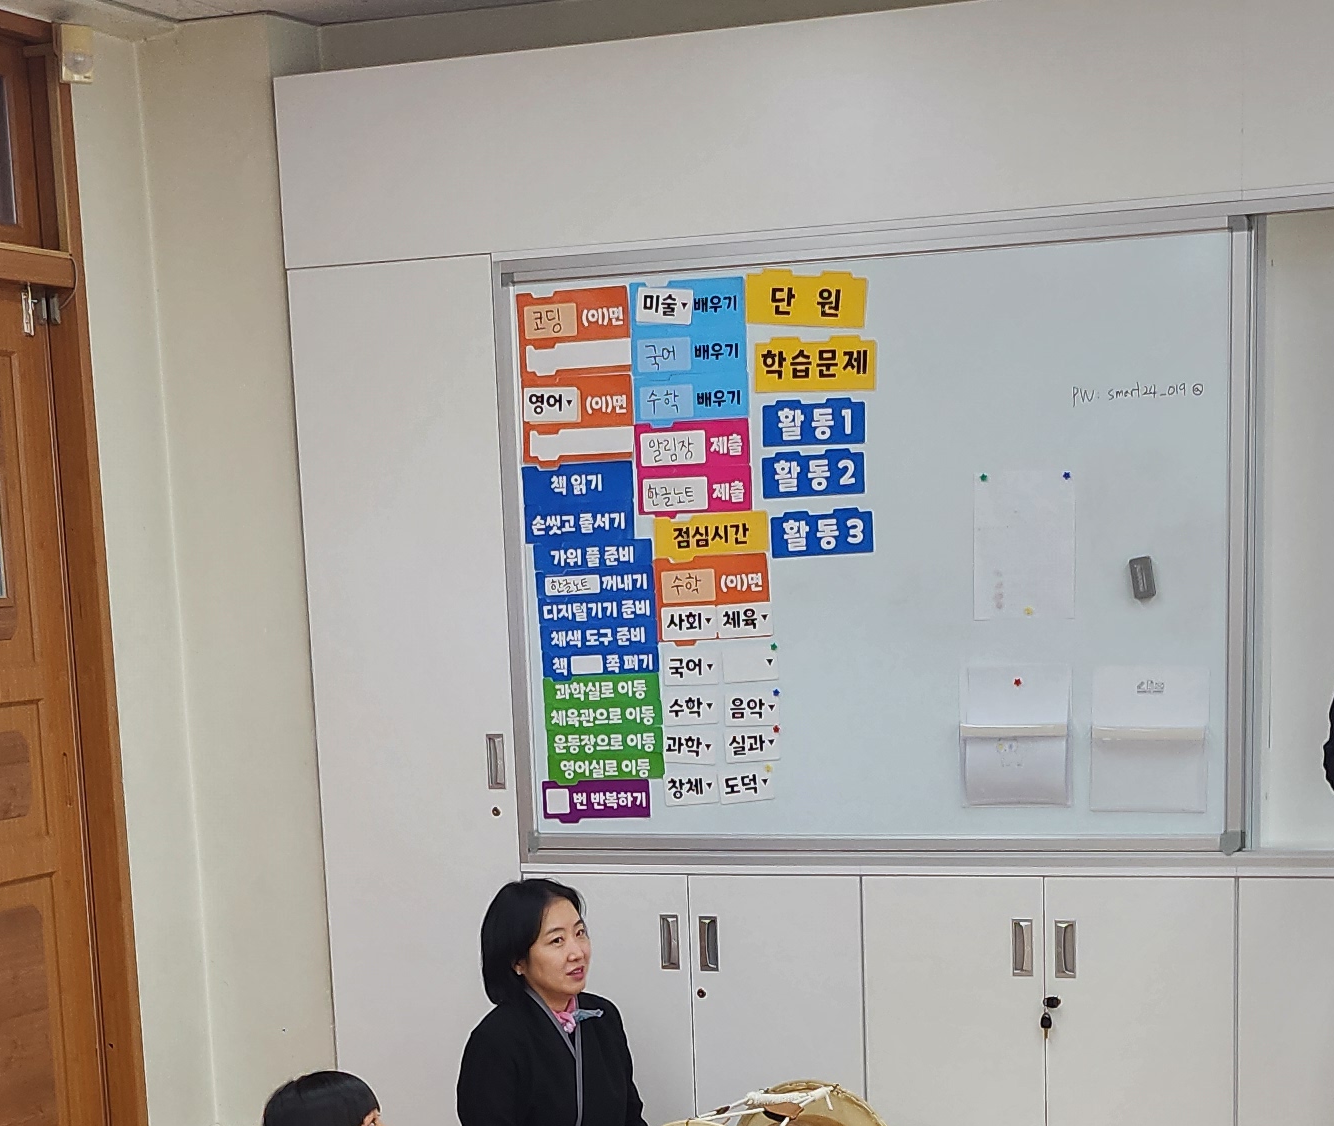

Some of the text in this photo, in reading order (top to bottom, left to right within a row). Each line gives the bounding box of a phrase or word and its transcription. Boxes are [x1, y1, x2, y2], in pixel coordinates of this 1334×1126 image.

[643, 294, 737, 317] 미술 배우기
[532, 306, 623, 334] 코딩 (이)면
[645, 342, 739, 370] 국어 배우기
[761, 348, 868, 379] 학습문제
[528, 393, 626, 416] 영어 (이)면
[647, 390, 741, 415] 수학 배우기
[648, 434, 742, 462] 알림장 제출
[550, 472, 602, 495] 책 읽기
[647, 481, 745, 508] 한글노트 제출
[531, 511, 625, 534] 손씻고 줄서기
[673, 522, 748, 549] 점심시간
[551, 546, 634, 566] 가위 풀 준비
[549, 573, 648, 593] 한글노트 꺼내기
[671, 573, 762, 595] 수학 (이)면
[543, 600, 650, 620] 디지털기기 준비
[667, 607, 758, 631] 사회 체육
[551, 626, 645, 647] 채색 도구 준비
[553, 653, 653, 675] 책 쪽 펴기
[668, 656, 703, 678] 국어
[555, 680, 646, 700] 과학실로 이동
[551, 706, 655, 727] 체육관으로 이동
[669, 696, 765, 720] 수학 음악
[554, 731, 655, 753] 운동장으로 이동
[666, 734, 765, 757] 과학 실과
[560, 758, 650, 778] 영어실로 이동
[667, 774, 758, 798] 창체 도덕
[573, 790, 646, 808] 번 반복하기
